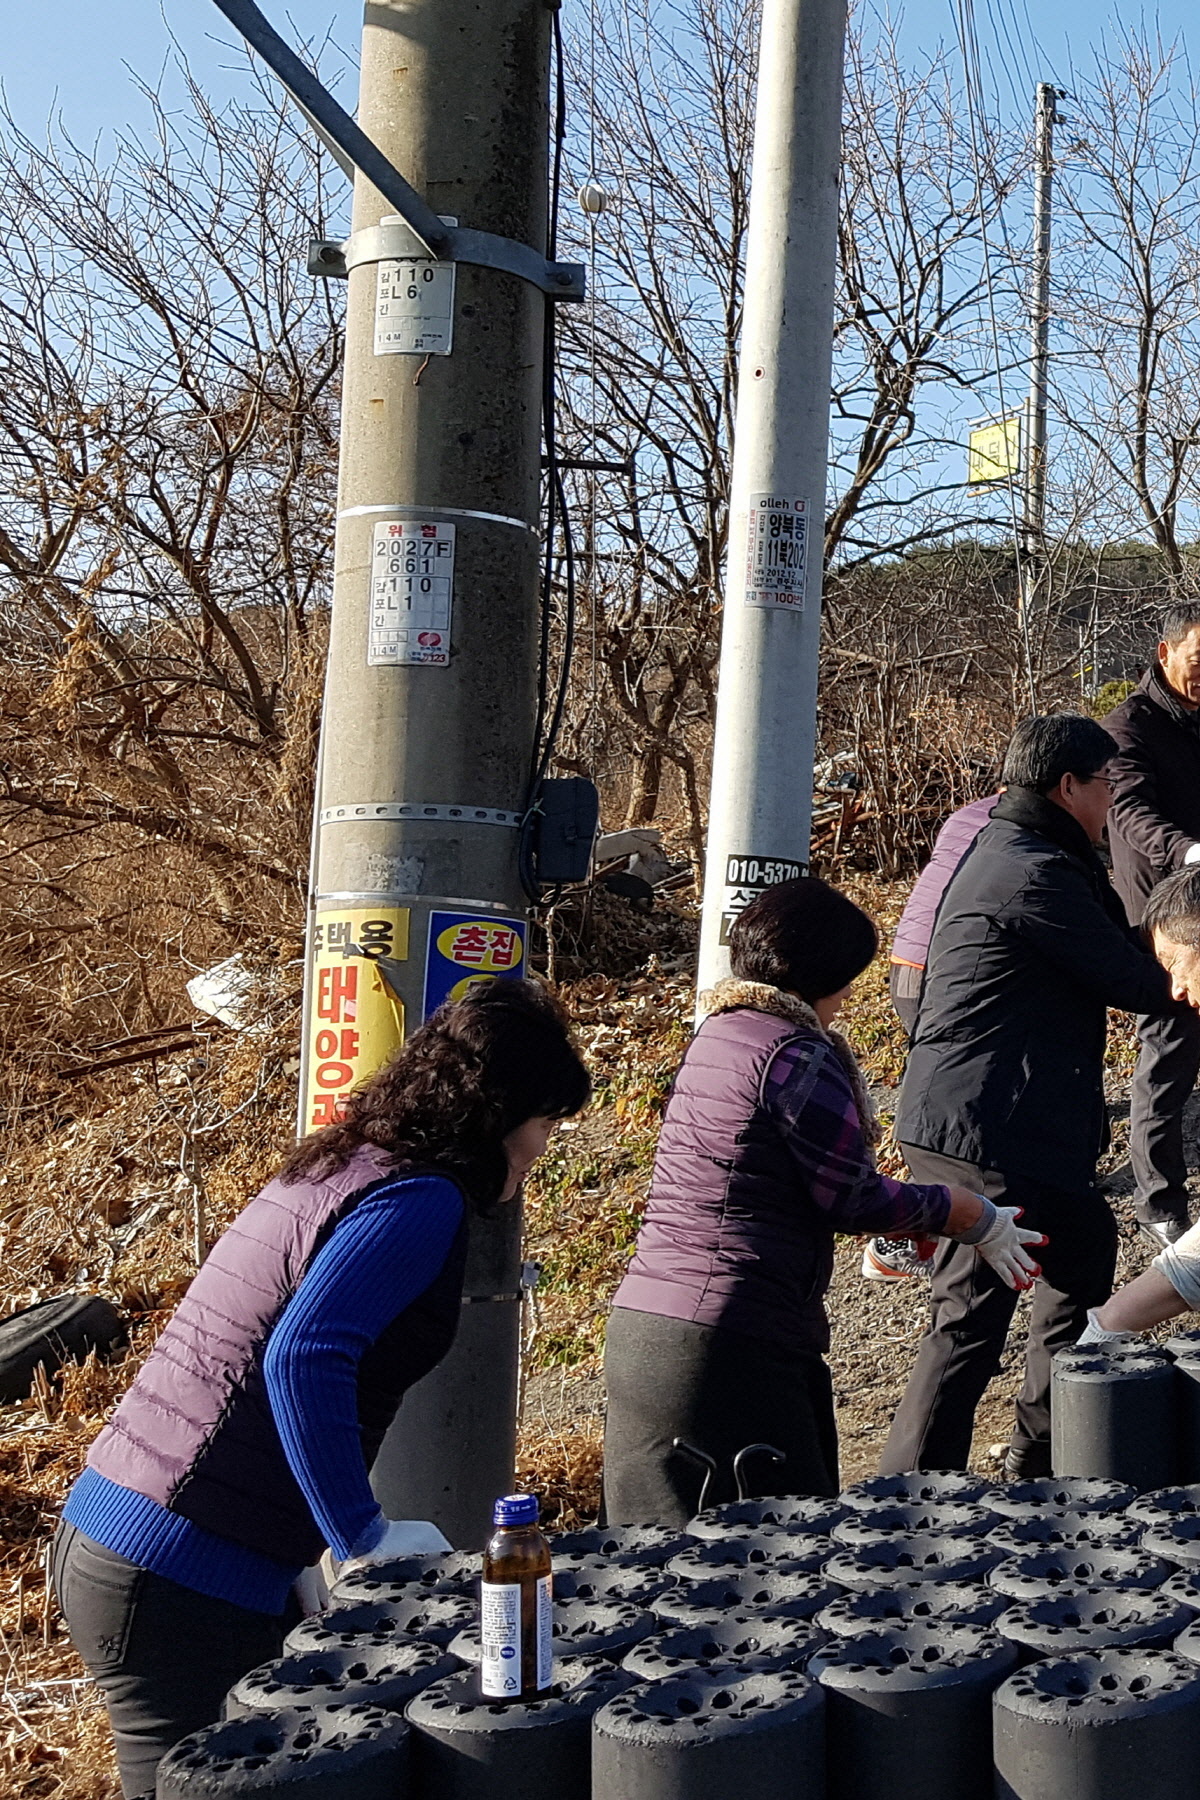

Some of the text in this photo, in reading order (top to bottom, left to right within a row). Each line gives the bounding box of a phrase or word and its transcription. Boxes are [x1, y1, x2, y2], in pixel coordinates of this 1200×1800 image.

[394, 268, 434, 283] 110
[760, 497, 790, 509] olleh
[769, 513, 806, 540] 양북동
[376, 541, 449, 557] 2027F
[768, 539, 805, 569] 11북202
[389, 557, 430, 574] 661
[766, 568, 796, 579] 2012.12
[389, 578, 432, 593] 110
[451, 925, 518, 967] 촌집
